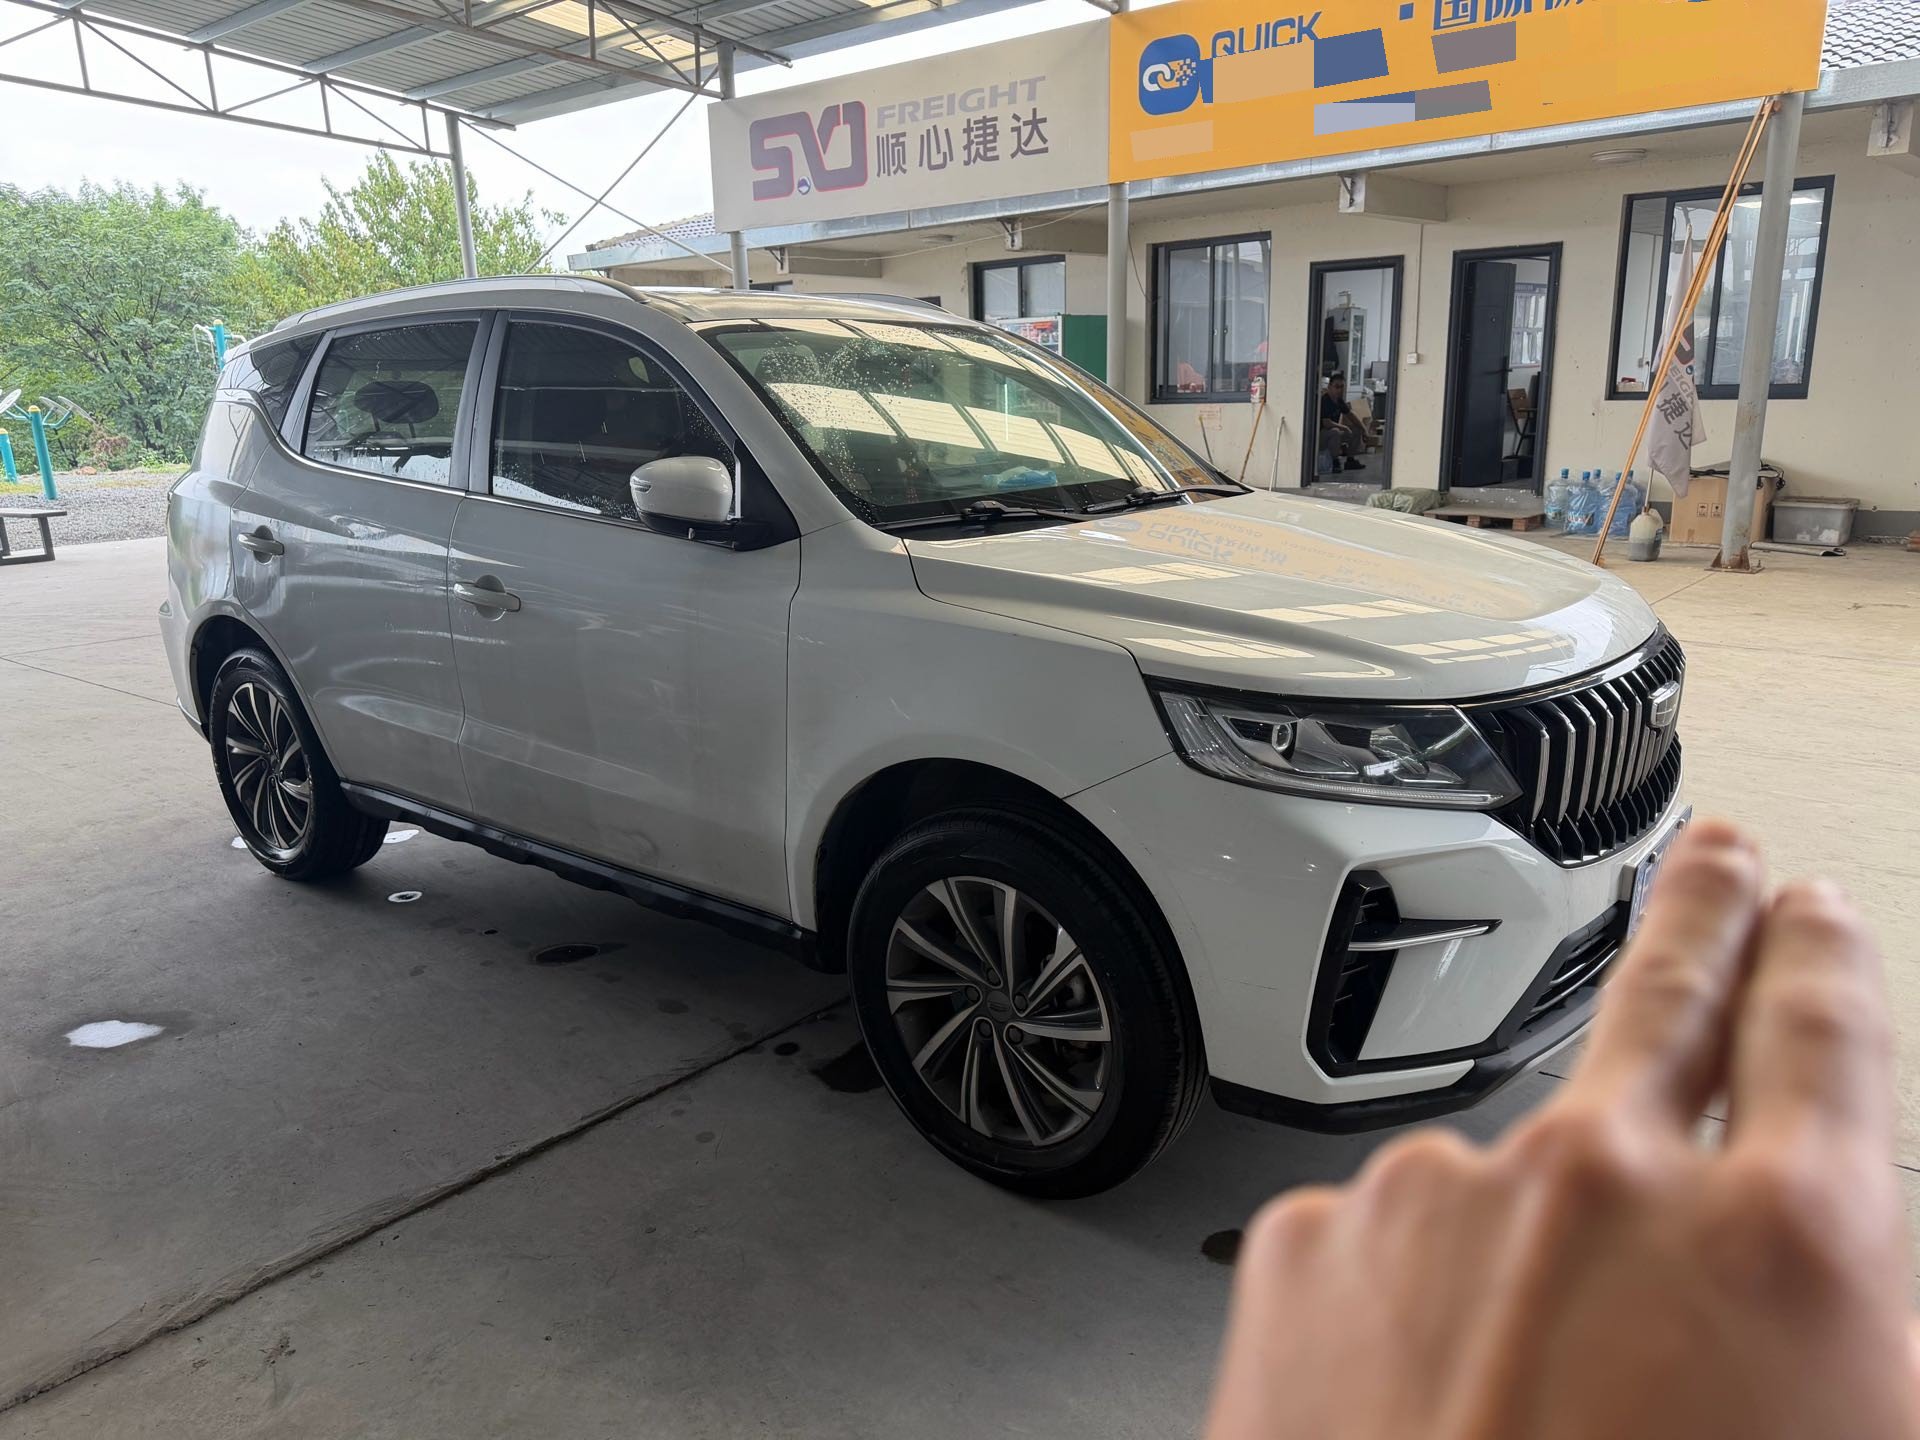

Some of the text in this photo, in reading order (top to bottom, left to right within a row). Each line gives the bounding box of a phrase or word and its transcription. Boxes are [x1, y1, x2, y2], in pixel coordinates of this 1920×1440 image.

[1211, 11, 1322, 59] QUICK
[876, 75, 1047, 129] FREIGHT
[876, 107, 1049, 178] 顺心捷达
